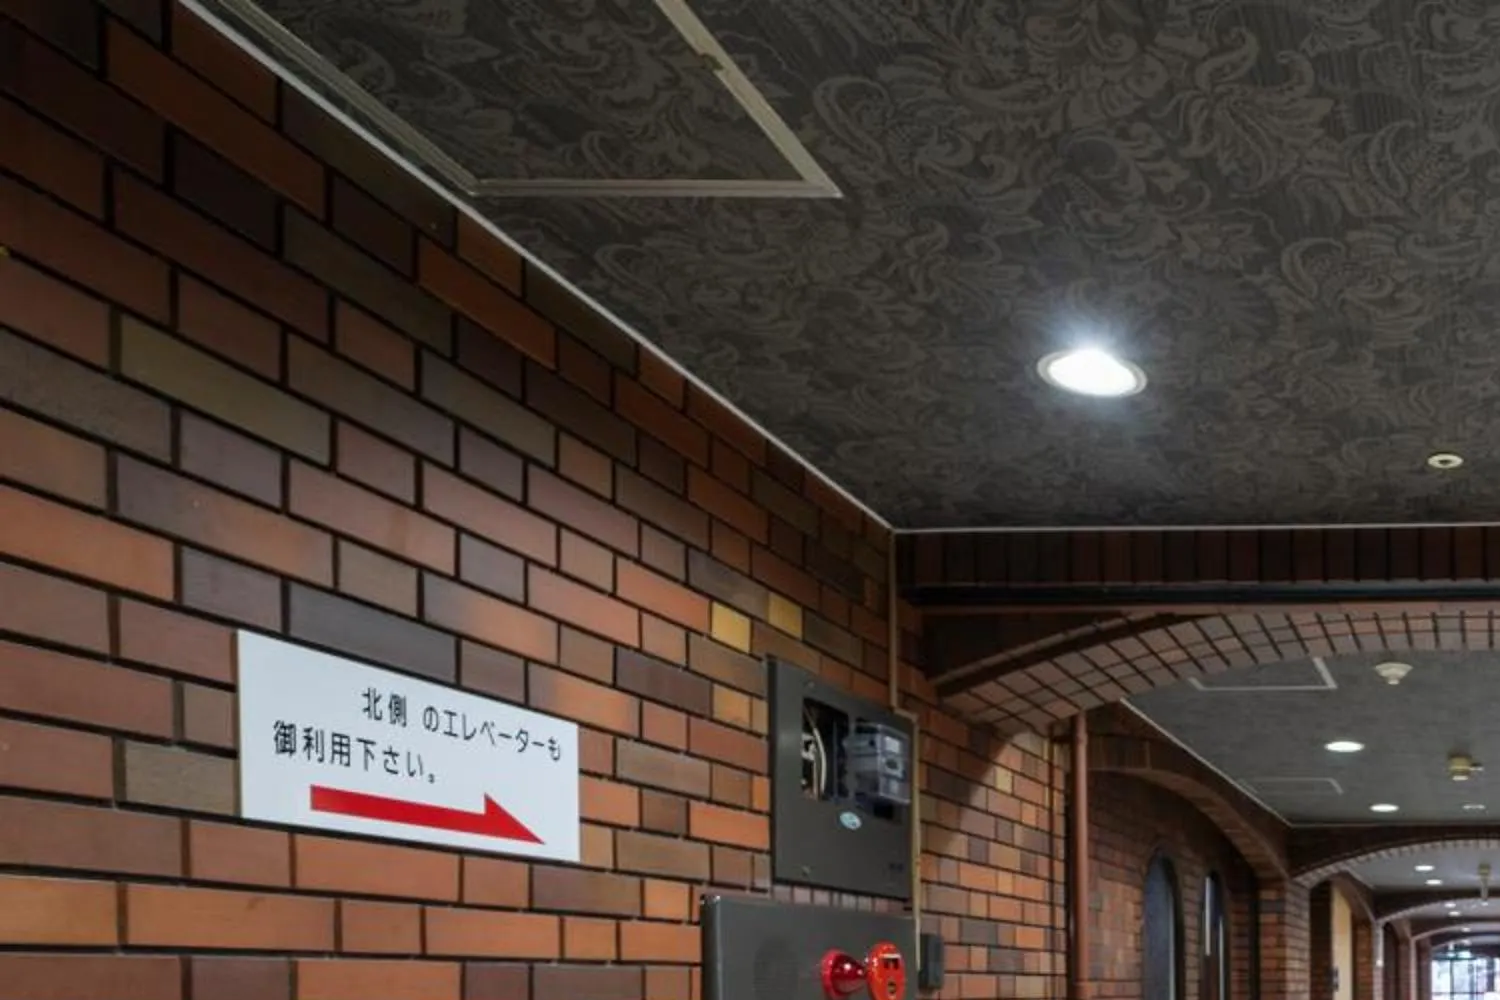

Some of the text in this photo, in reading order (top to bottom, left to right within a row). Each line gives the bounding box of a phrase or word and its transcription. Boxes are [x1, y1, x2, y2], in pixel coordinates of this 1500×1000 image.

[273, 719, 436, 785] 御利用下さい。
[361, 687, 562, 763] 北側 のエレベーターも
